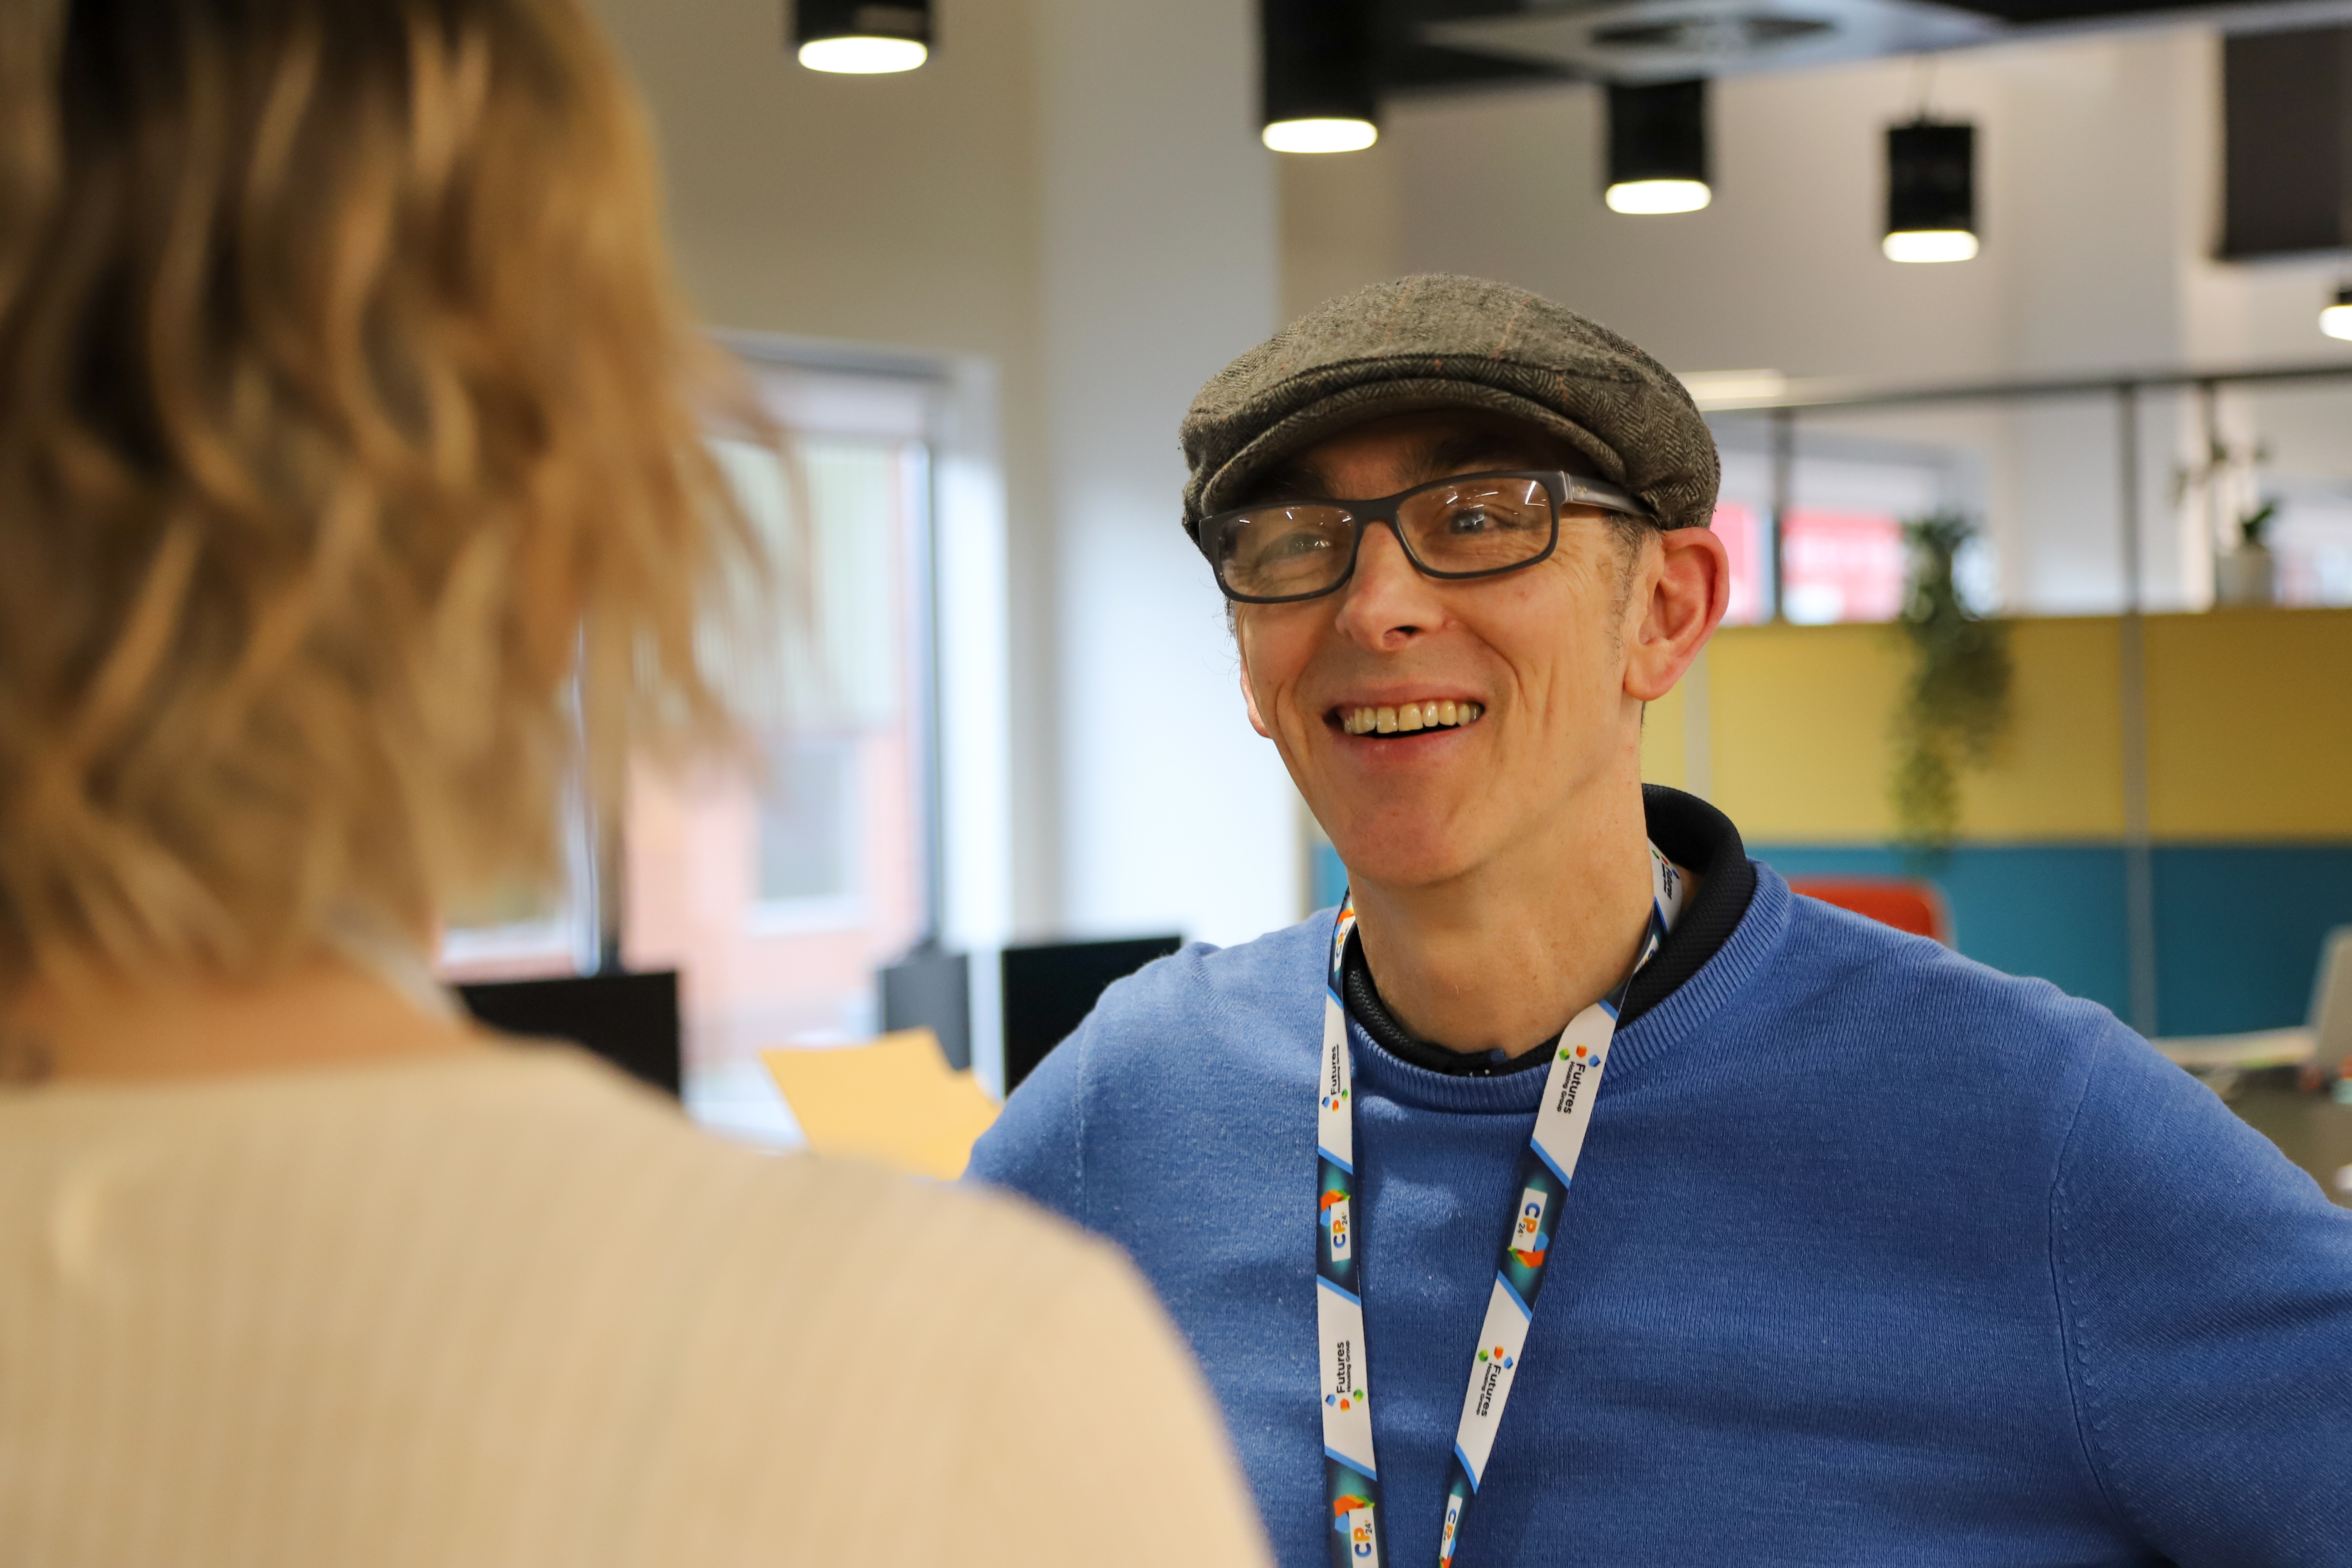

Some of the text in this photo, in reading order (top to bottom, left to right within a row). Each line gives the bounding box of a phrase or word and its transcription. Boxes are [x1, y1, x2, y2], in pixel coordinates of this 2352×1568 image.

[1557, 1061, 1575, 1112] Housing Group
[1564, 1063, 1586, 1114] Futures
[1333, 1220, 1346, 1249] CP
[1523, 1202, 1540, 1233] CP
[1336, 1342, 1345, 1393] Futures
[1476, 1363, 1493, 1415] Housing Group
[1481, 1364, 1501, 1417] Futures
[1354, 1527, 1372, 1558] CP
[1447, 1508, 1456, 1540] CP
